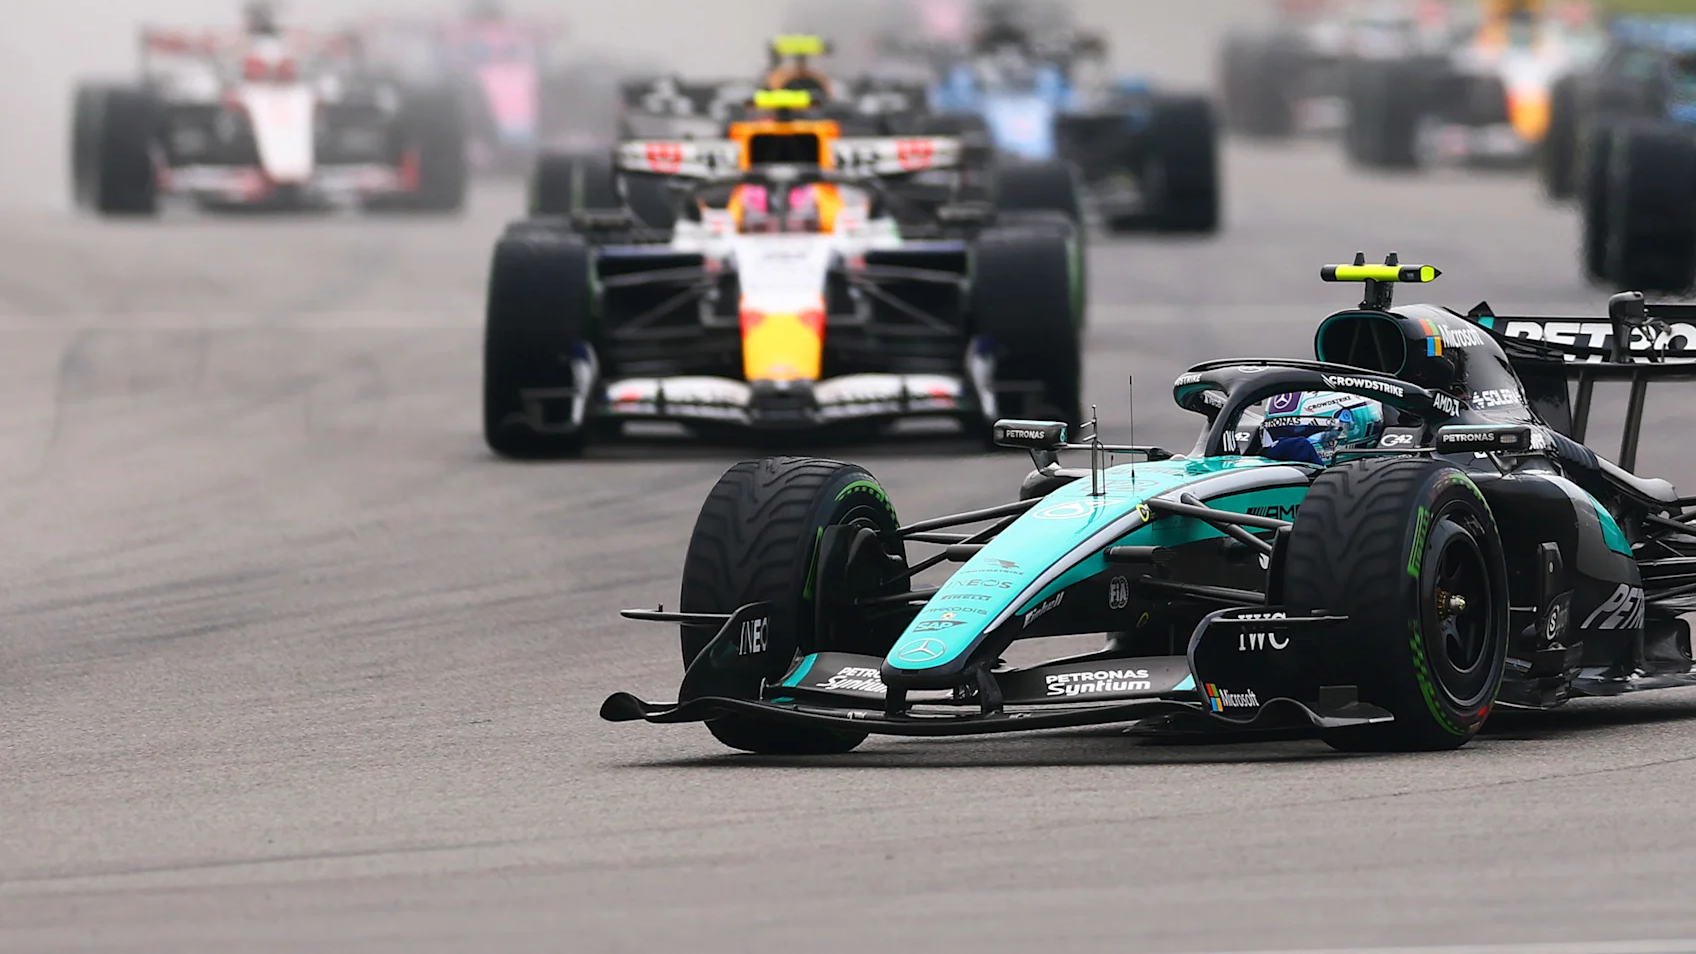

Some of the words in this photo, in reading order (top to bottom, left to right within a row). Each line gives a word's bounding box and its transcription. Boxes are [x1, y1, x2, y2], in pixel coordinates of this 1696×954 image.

[1328, 375, 1404, 397] CROWDSTRIKE
[1308, 396, 1351, 410] CROWDSTRIKE
[1006, 429, 1045, 440] PETRONAS
[1443, 432, 1495, 443] PETRONAS
[945, 579, 1013, 589] INEOS
[1022, 591, 1065, 630] Einhell
[1046, 669, 1150, 684] PETRONAS
[1046, 679, 1151, 697] Syntium
[1221, 688, 1260, 707] Microsoft
